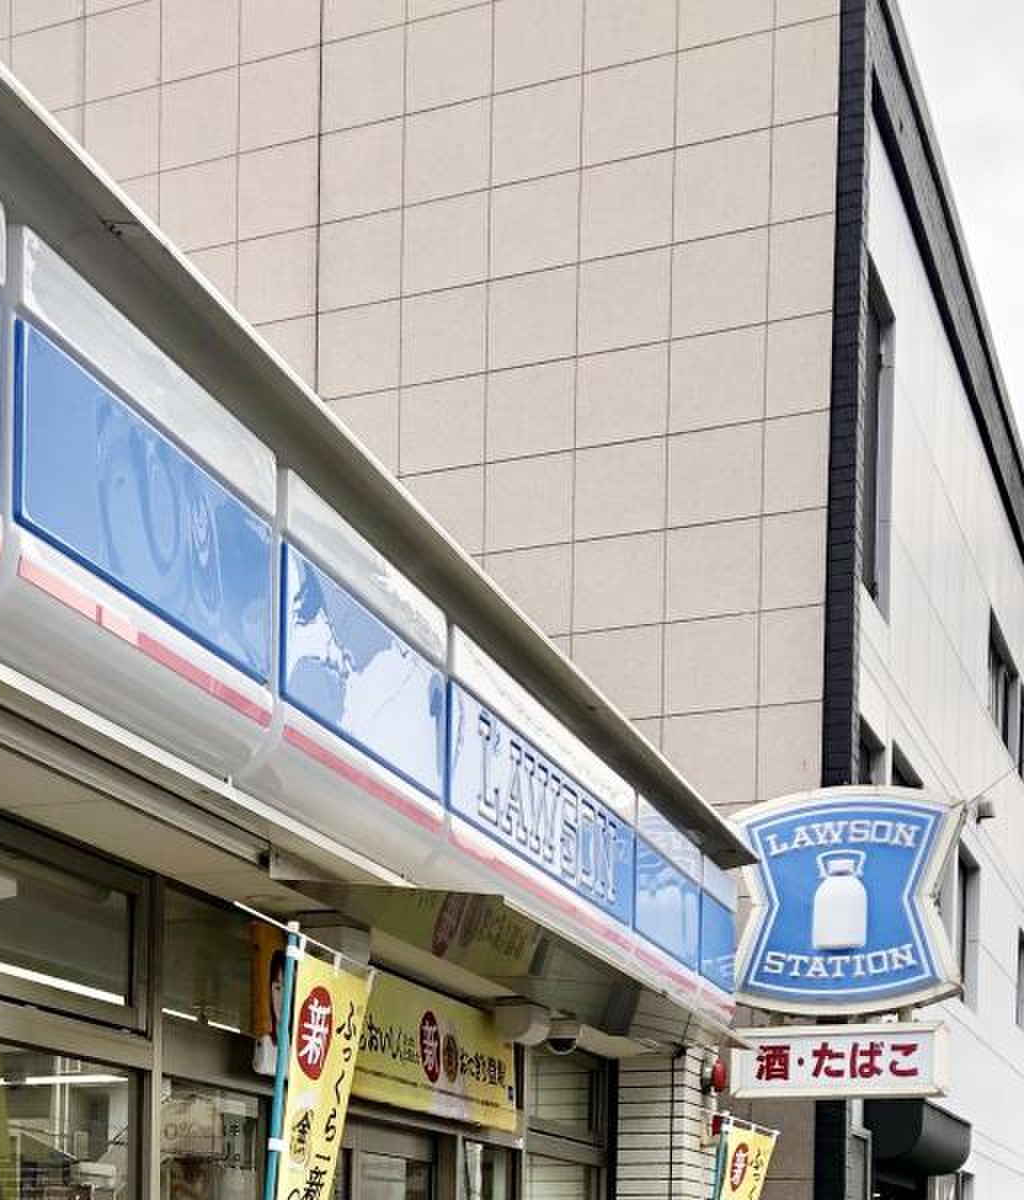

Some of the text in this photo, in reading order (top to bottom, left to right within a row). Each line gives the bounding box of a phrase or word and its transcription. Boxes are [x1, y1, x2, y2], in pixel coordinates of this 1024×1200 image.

[478, 712, 619, 906] LAWSON
[767, 819, 923, 856] LAWSON
[764, 943, 916, 978] STATION
[298, 998, 331, 1066] 新
[755, 1041, 919, 1081] 酒・たばこ
